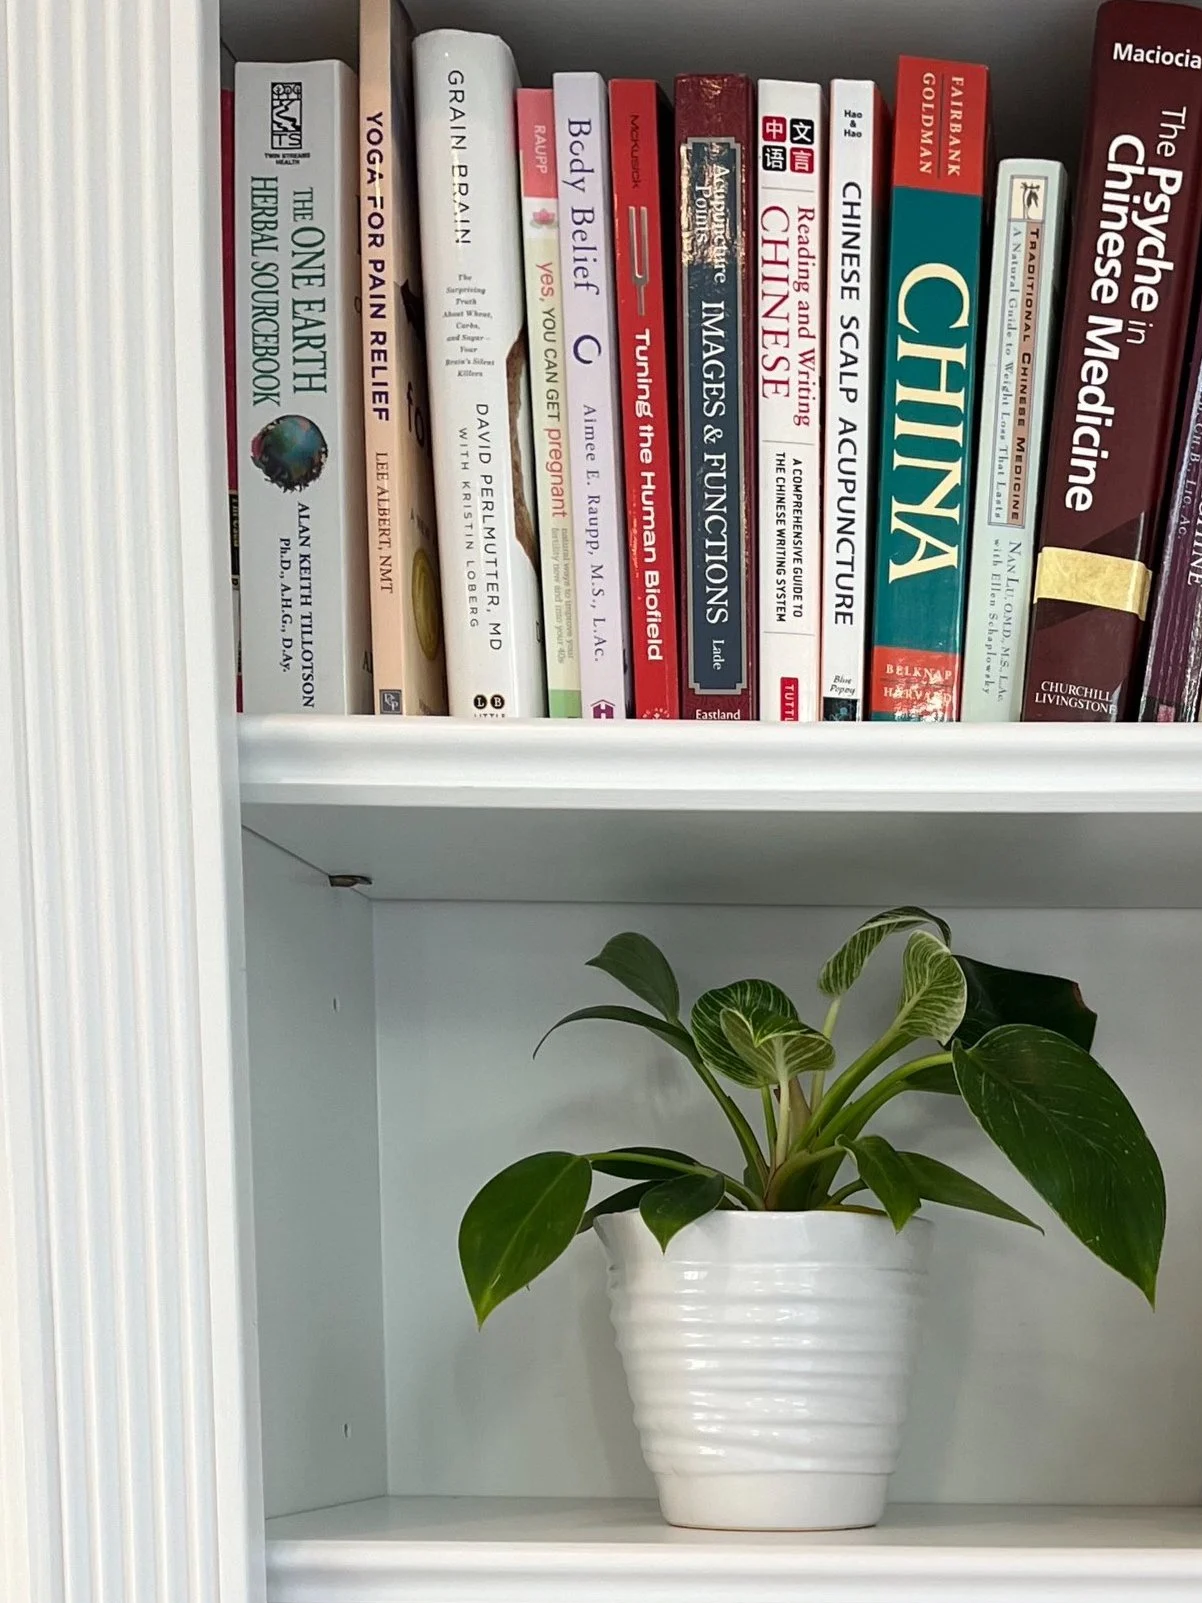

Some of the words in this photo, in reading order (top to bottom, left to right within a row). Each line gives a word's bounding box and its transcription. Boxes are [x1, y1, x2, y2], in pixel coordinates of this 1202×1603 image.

[1112, 42, 1202, 69] Maciocia
[365, 111, 383, 184] YOGA
[562, 117, 595, 192] Body
[919, 72, 936, 173] GOLDMAN
[947, 76, 964, 176] FAIRBANK
[1148, 106, 1186, 172] The
[250, 175, 278, 257] HERBAL
[292, 186, 313, 222] THE
[366, 195, 384, 248] FOR
[840, 181, 862, 300] CHINESE
[1090, 133, 1144, 304] Chinese
[1130, 166, 1183, 312] Psyche
[290, 225, 326, 290] ONE
[367, 258, 386, 319] PAIN
[570, 206, 600, 296] Belief
[793, 206, 816, 293] Reading
[250, 260, 280, 406] SOURCEBOOK
[291, 297, 327, 394] EARTH
[760, 205, 790, 399] CHINESE
[797, 300, 816, 339] and
[1125, 319, 1153, 344] in
[369, 330, 389, 421] RELIEF
[634, 327, 653, 418] Tuning
[792, 347, 815, 426] Writing
[838, 314, 859, 403] SCALP
[638, 424, 654, 464] the
[888, 262, 969, 583] CHINA
[1064, 314, 1122, 511] Medicine
[640, 471, 656, 562] Human
[833, 416, 857, 625] ACUPUNCTURE
[644, 569, 663, 660] Biofield
